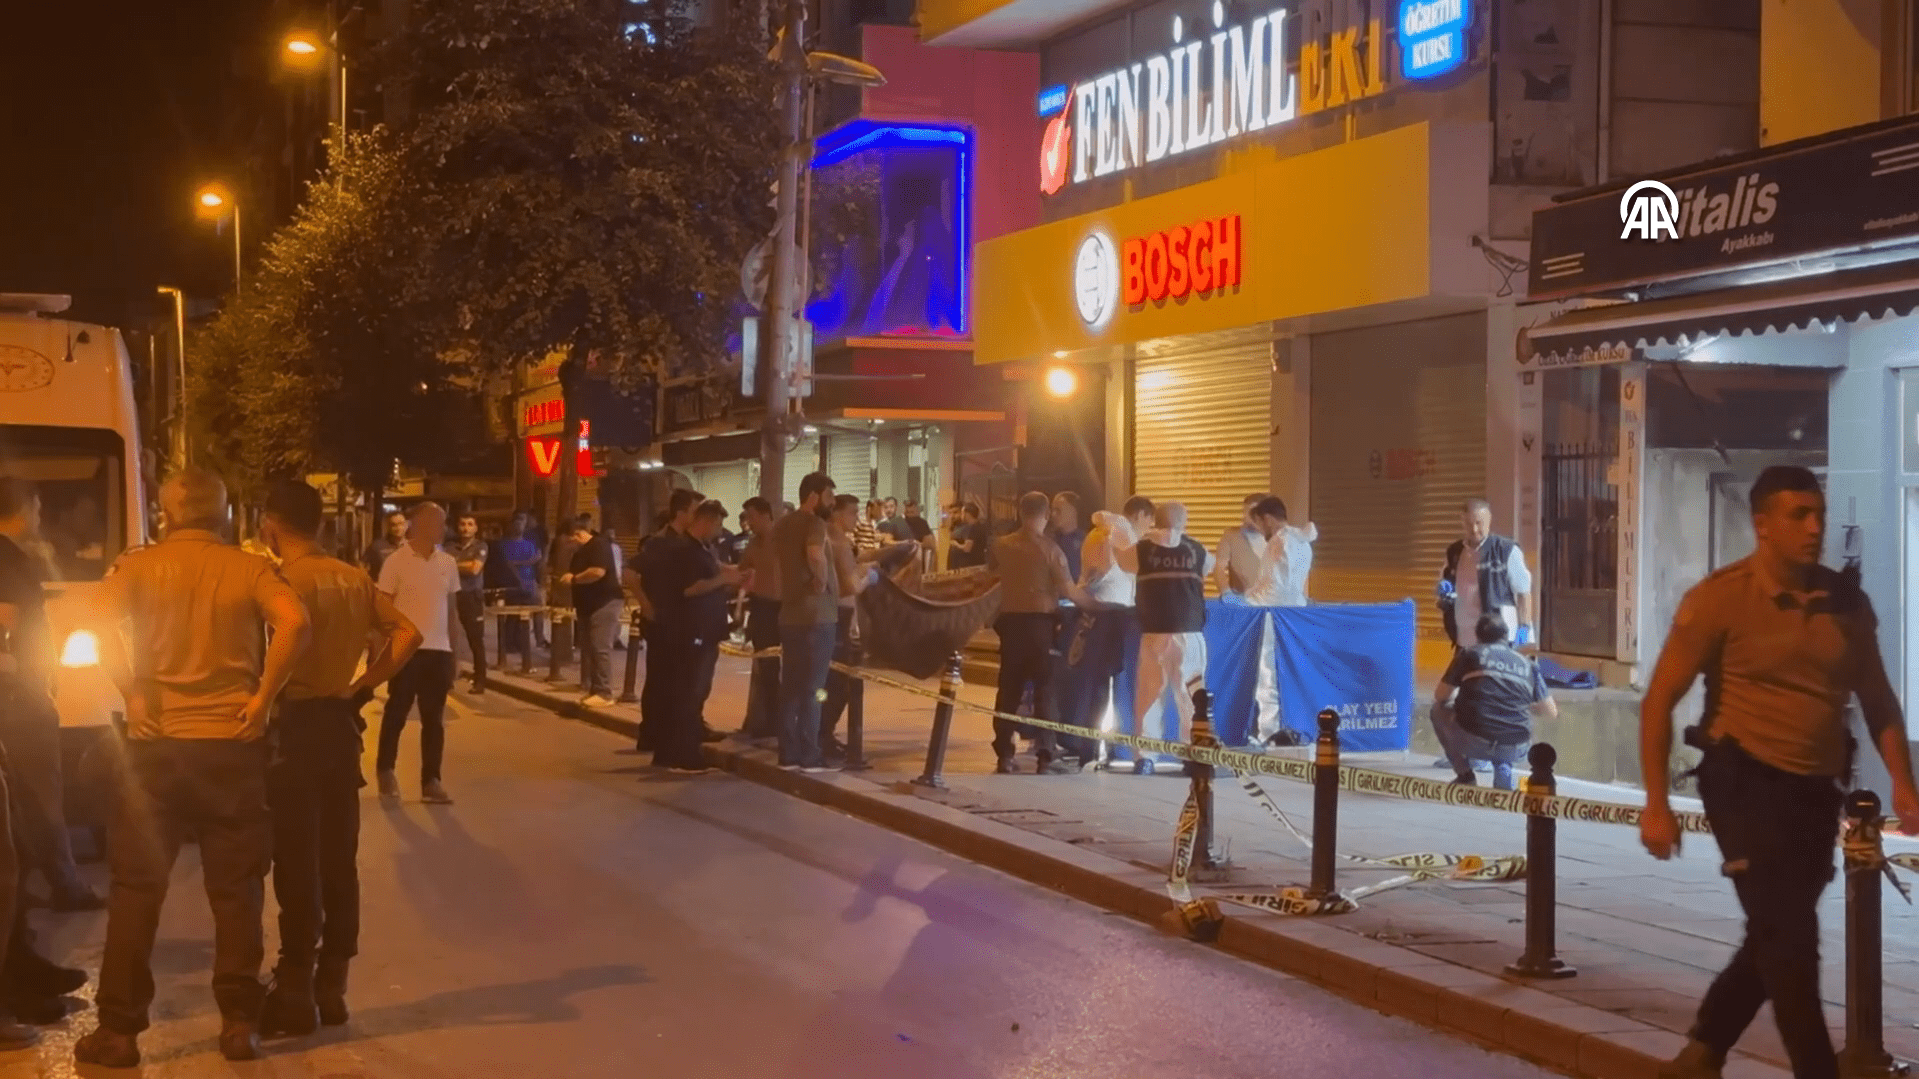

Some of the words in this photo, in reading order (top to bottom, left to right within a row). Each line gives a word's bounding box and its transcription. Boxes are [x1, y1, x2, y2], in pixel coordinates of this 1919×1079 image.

[1412, 32, 1453, 69] KURSU
[1073, 62, 1143, 184] FEN
[1123, 214, 1242, 305] BOSCH
[1720, 230, 1775, 255] Ayakkabı
[1364, 699, 1398, 715] YERİ
[1412, 781, 1442, 801] POLİS
[1455, 787, 1508, 811] GİRİLMEZ
[1523, 796, 1560, 818] POLİS
